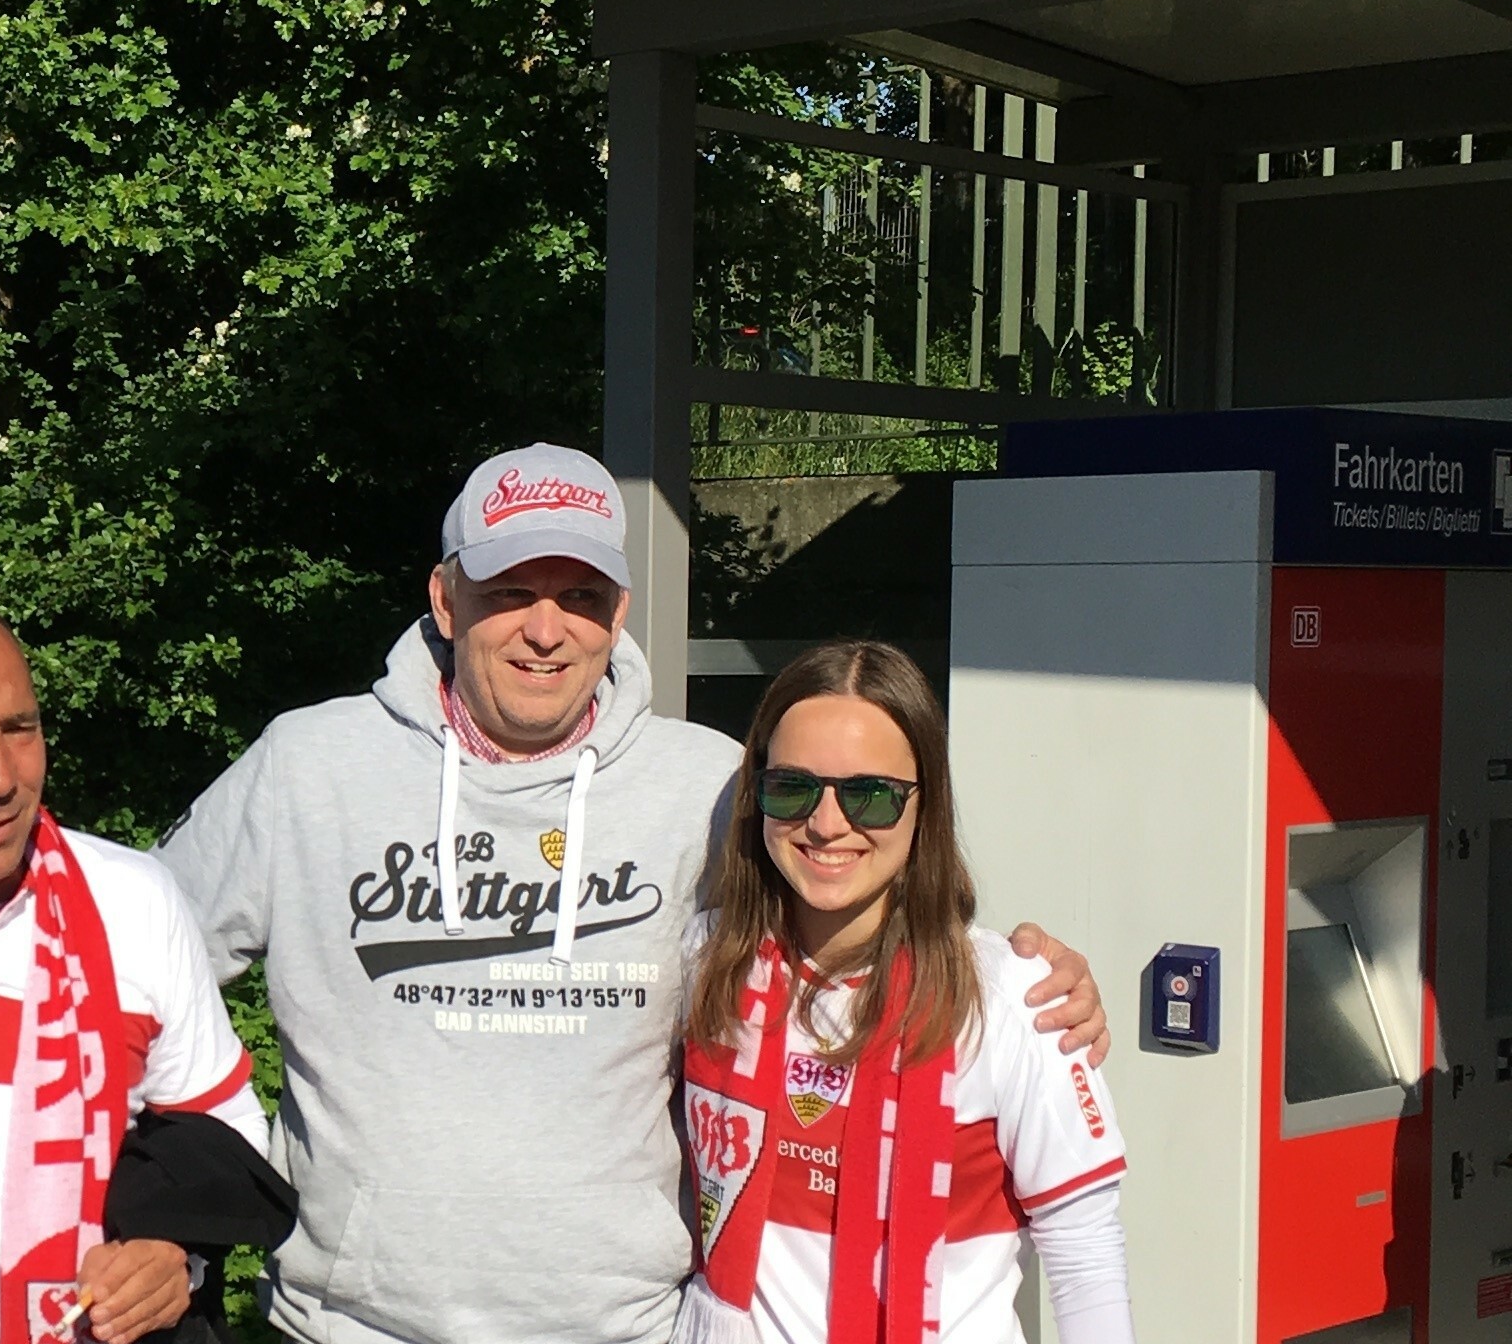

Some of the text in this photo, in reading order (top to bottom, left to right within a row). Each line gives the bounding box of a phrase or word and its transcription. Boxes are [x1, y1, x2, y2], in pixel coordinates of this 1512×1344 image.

[1334, 442, 1465, 494] Fahrkarten
[482, 467, 613, 523] Stuttgart
[1294, 611, 1318, 641] DB
[489, 962, 660, 984] BEWEGT SEIT 1893
[435, 1010, 588, 1036] BAD CANNSTATT
